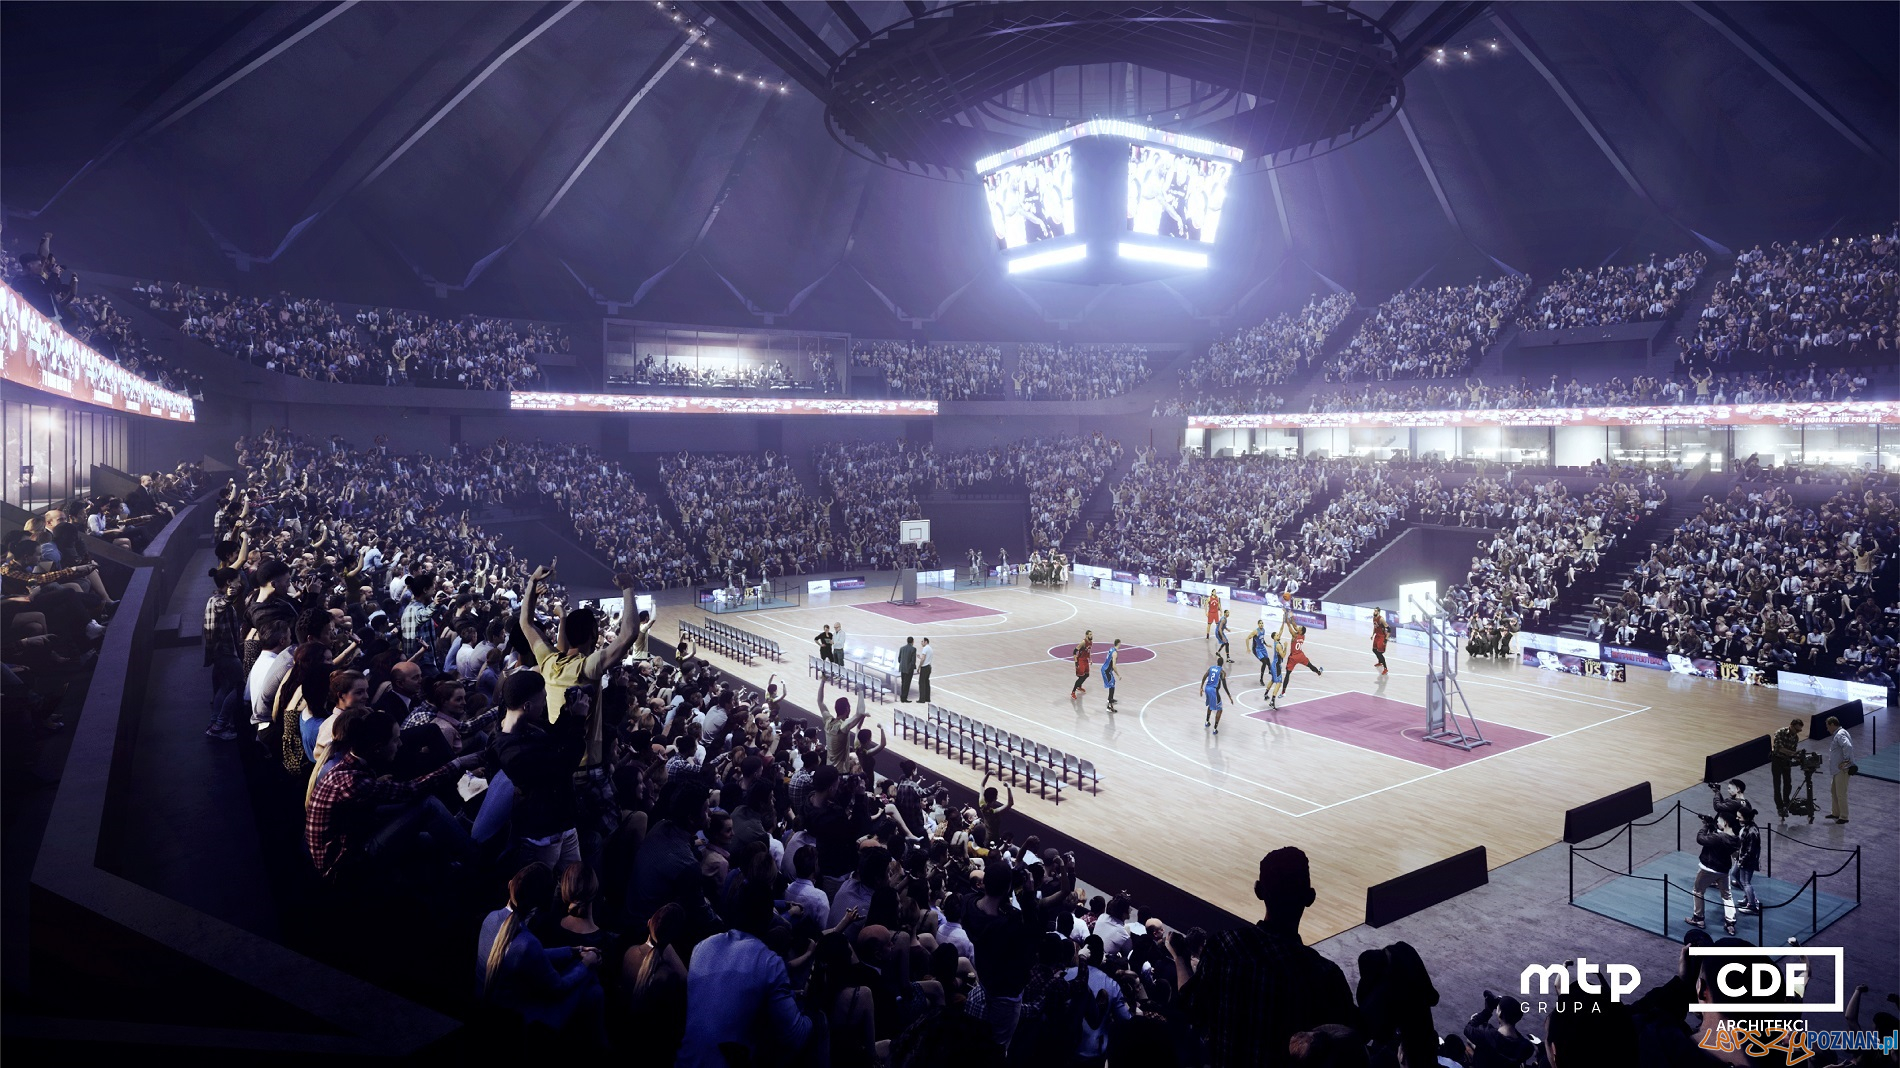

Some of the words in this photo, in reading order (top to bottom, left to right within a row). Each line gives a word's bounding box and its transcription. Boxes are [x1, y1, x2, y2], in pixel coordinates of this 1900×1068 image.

[1584, 659, 1602, 667] SHOW
[1720, 661, 1739, 670] SHOW
[1584, 664, 1602, 675] US
[1720, 667, 1740, 680] US
[1210, 672, 1216, 682] 2
